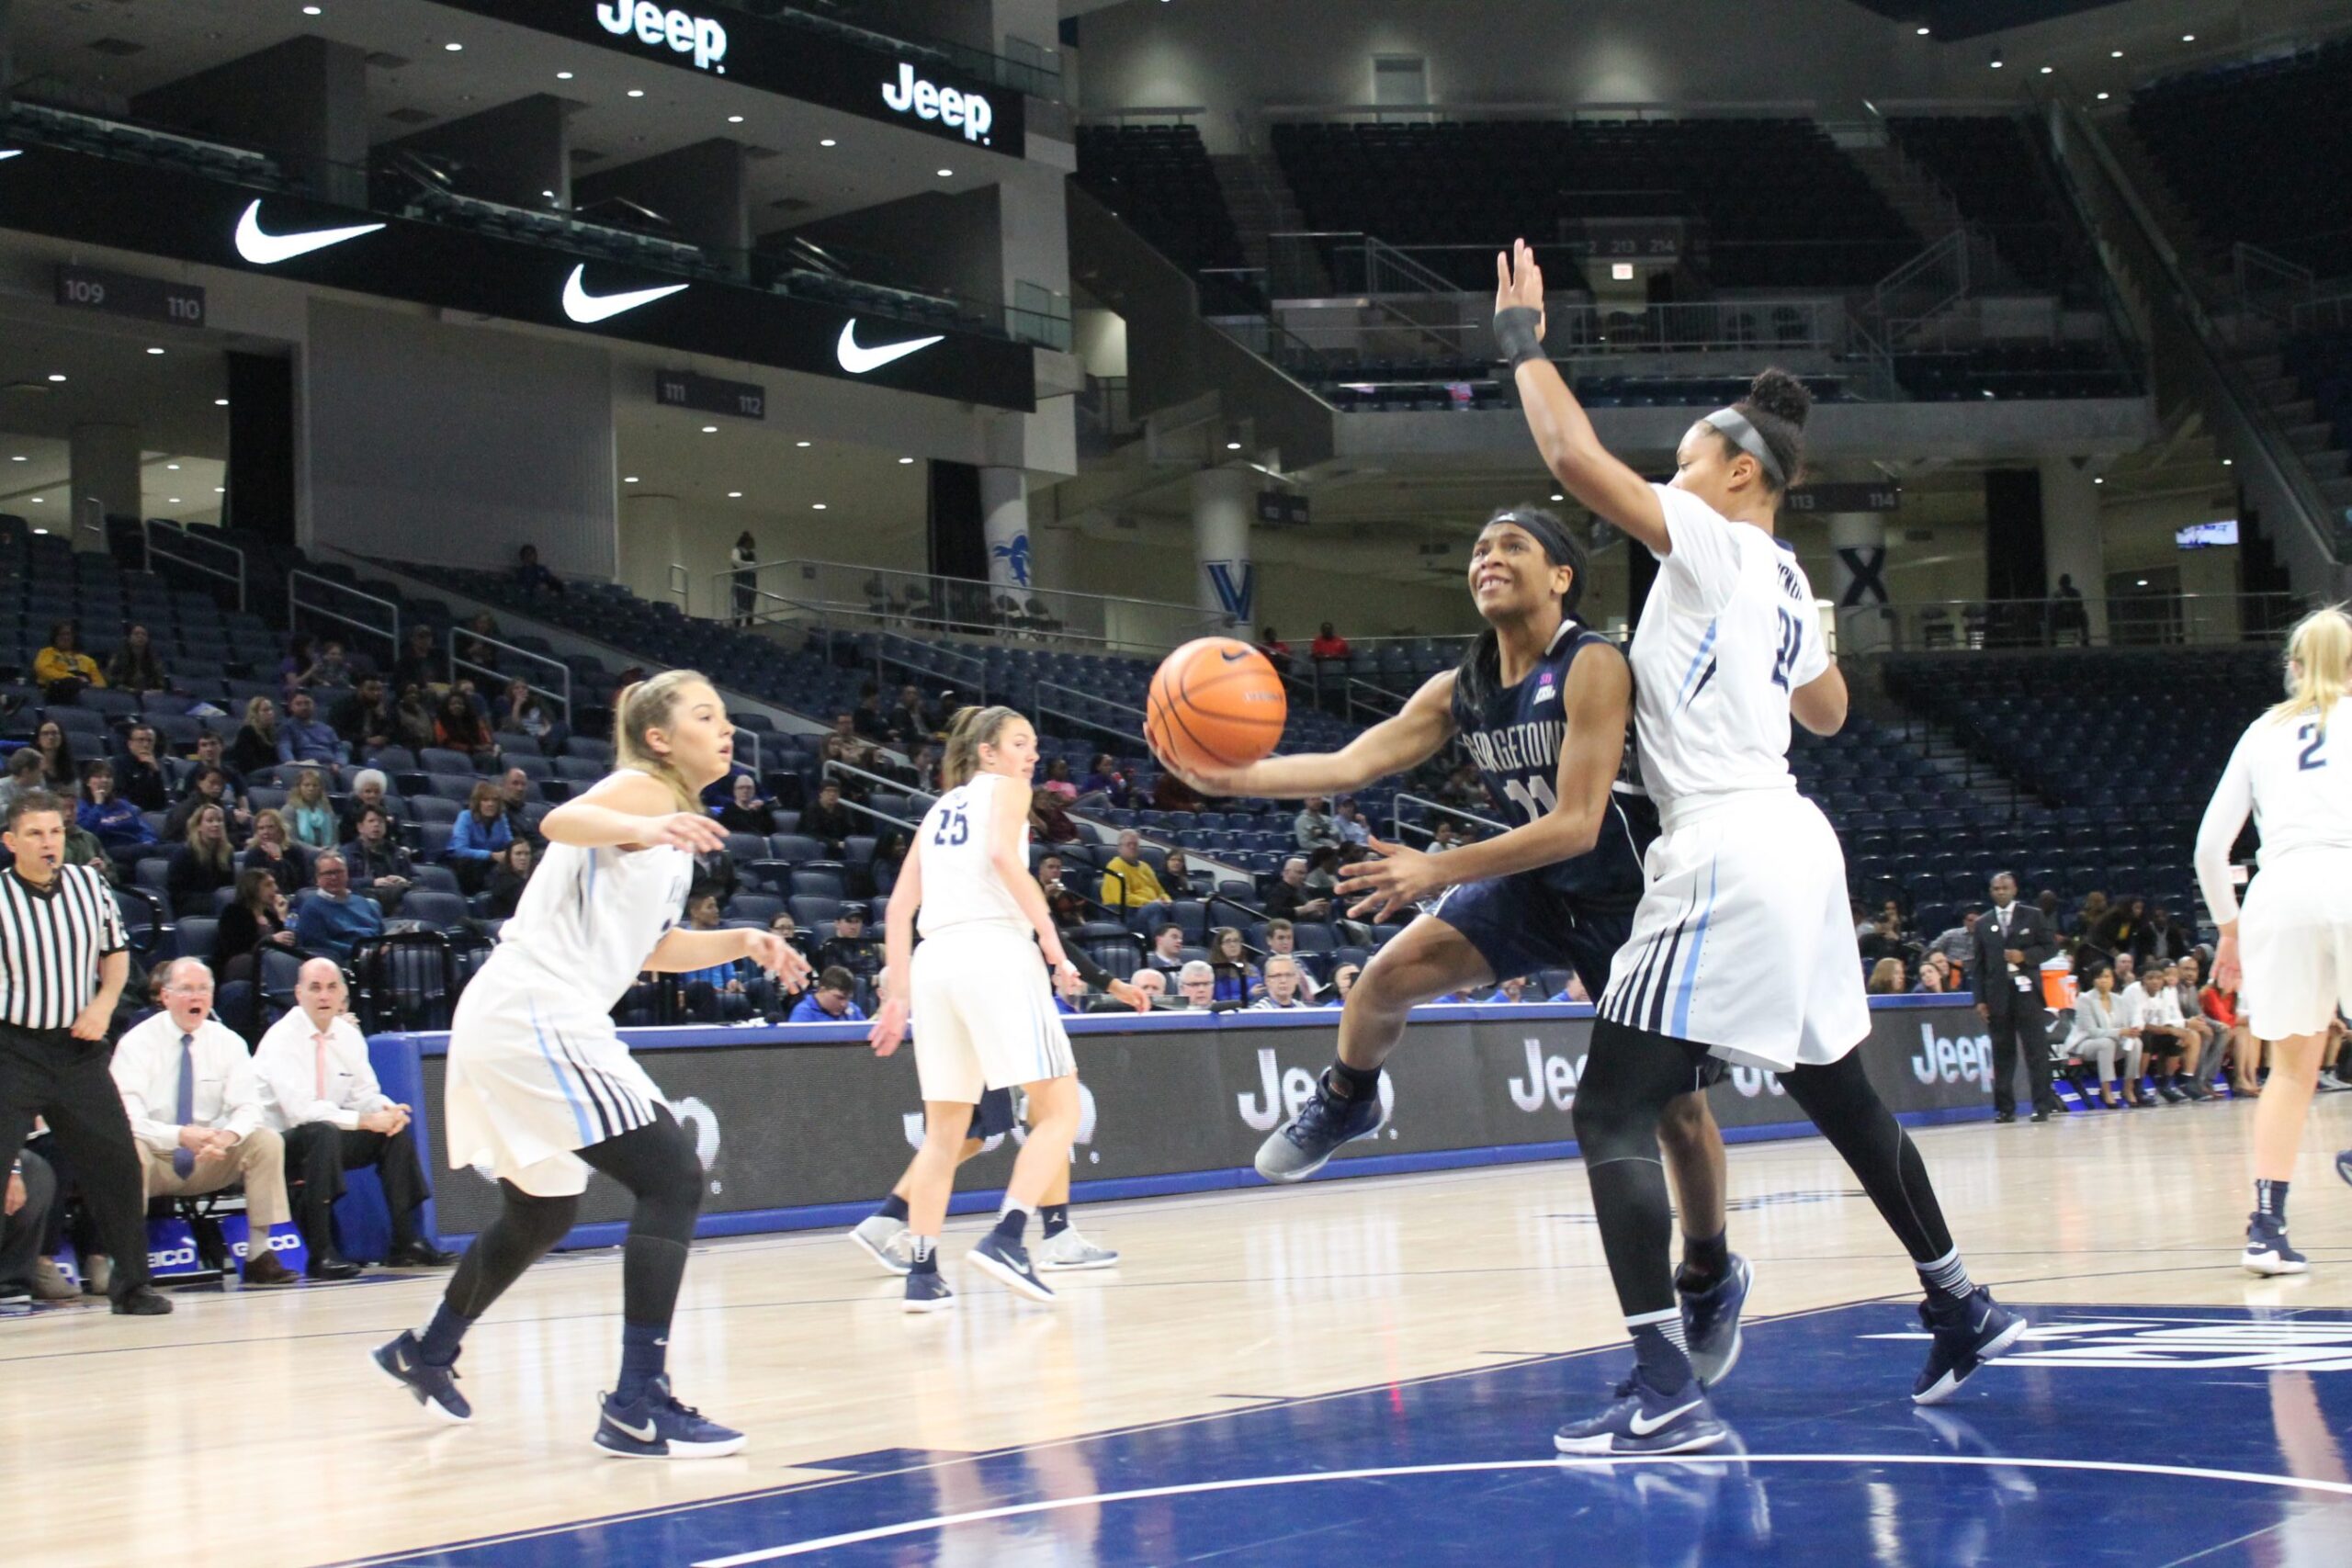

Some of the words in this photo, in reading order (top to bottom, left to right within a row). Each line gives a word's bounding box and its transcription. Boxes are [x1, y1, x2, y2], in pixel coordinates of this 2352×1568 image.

[882, 62, 992, 142] Jeep
[66, 280, 104, 303] 109
[167, 297, 199, 320] 110
[665, 382, 685, 401] 111
[739, 395, 762, 415] 112
[1790, 494, 1815, 509] 113
[1869, 492, 1894, 507] 114
[1202, 558, 1254, 626] V
[1837, 546, 1888, 608] X
[2298, 722, 2326, 771] 2
[1508, 1038, 1588, 1111] Je
[147, 1247, 196, 1268] EICO
[232, 1234, 300, 1258] GCO
